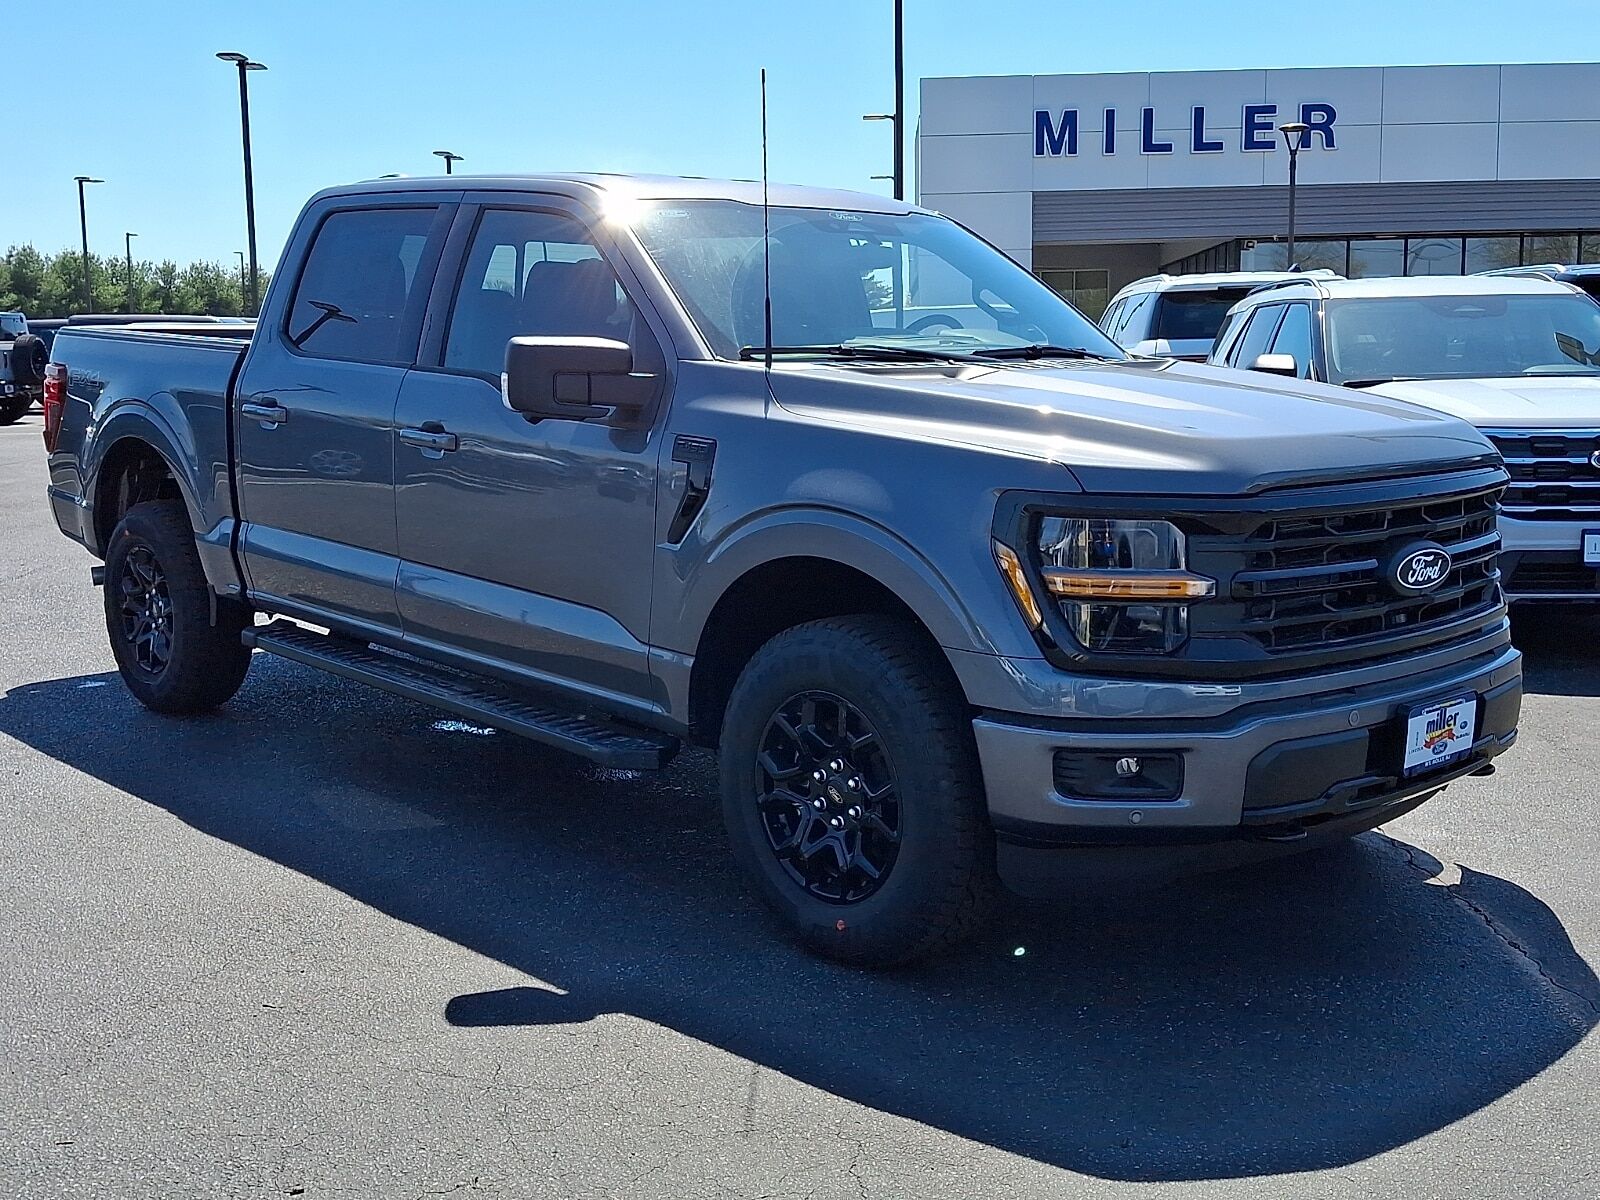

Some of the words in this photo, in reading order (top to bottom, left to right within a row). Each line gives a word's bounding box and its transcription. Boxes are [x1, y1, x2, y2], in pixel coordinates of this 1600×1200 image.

[1034, 103, 1338, 156] MILLER
[69, 369, 104, 387] FX4
[1408, 555, 1442, 583] Ford
[1426, 708, 1459, 735] miller
